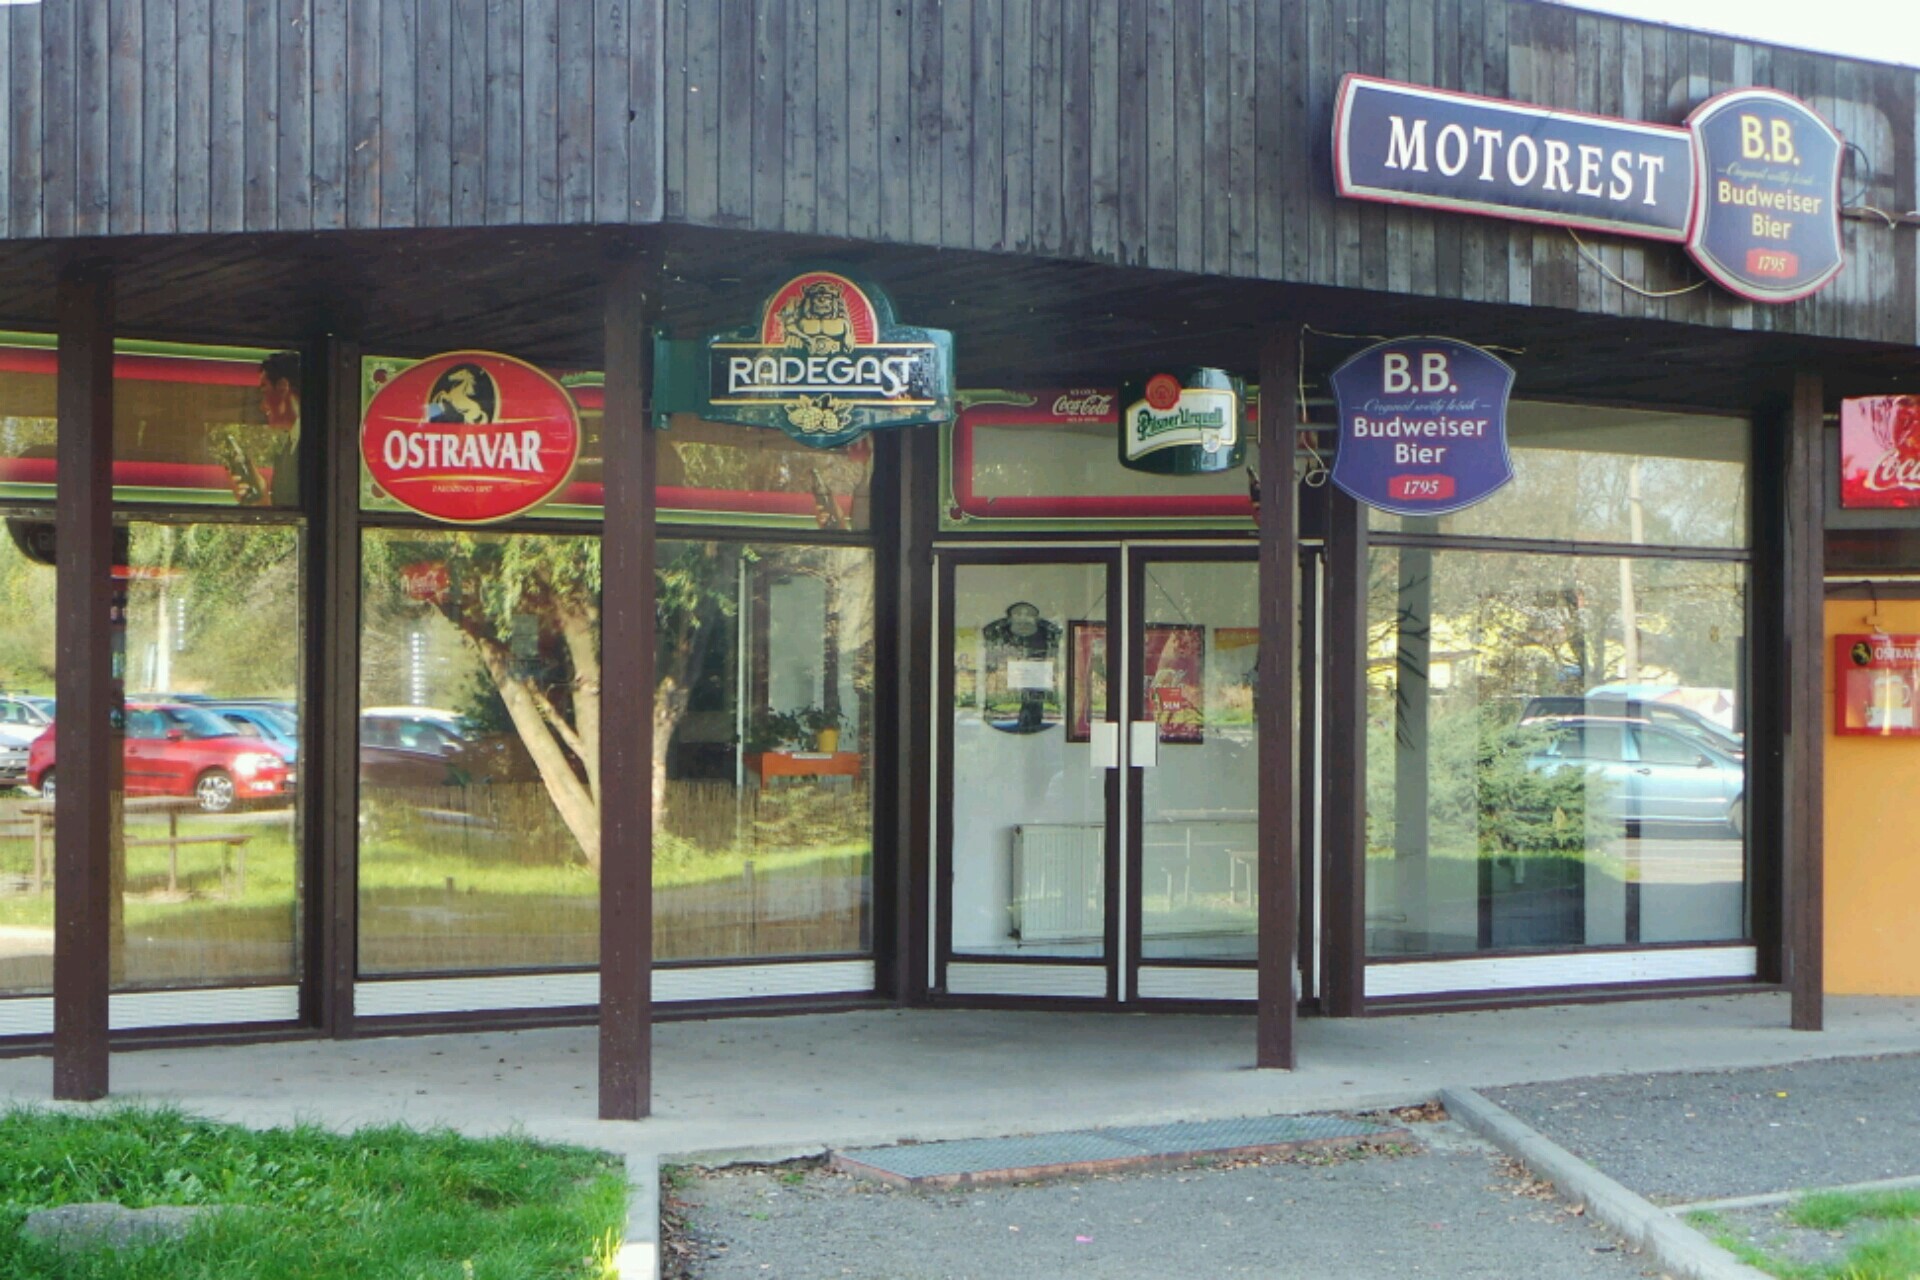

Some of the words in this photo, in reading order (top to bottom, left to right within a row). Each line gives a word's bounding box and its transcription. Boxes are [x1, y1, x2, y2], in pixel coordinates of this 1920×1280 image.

[1740, 115, 1800, 166] B.B.
[1385, 116, 1664, 206] MOTOREST
[1718, 180, 1823, 214] Budweiser
[1752, 213, 1792, 240] Bier
[1758, 255, 1787, 271] 1795
[728, 356, 920, 397] RADEGAST
[1383, 353, 1458, 394] B.B.
[1052, 394, 1113, 416] Coca-Cola
[1136, 409, 1179, 442] Pilsner
[1179, 407, 1224, 431] Urquell
[1354, 416, 1487, 438] Budweiser
[384, 430, 544, 472] OSTRAVAR
[1395, 443, 1446, 464] Bier
[1403, 481, 1439, 495] 1795
